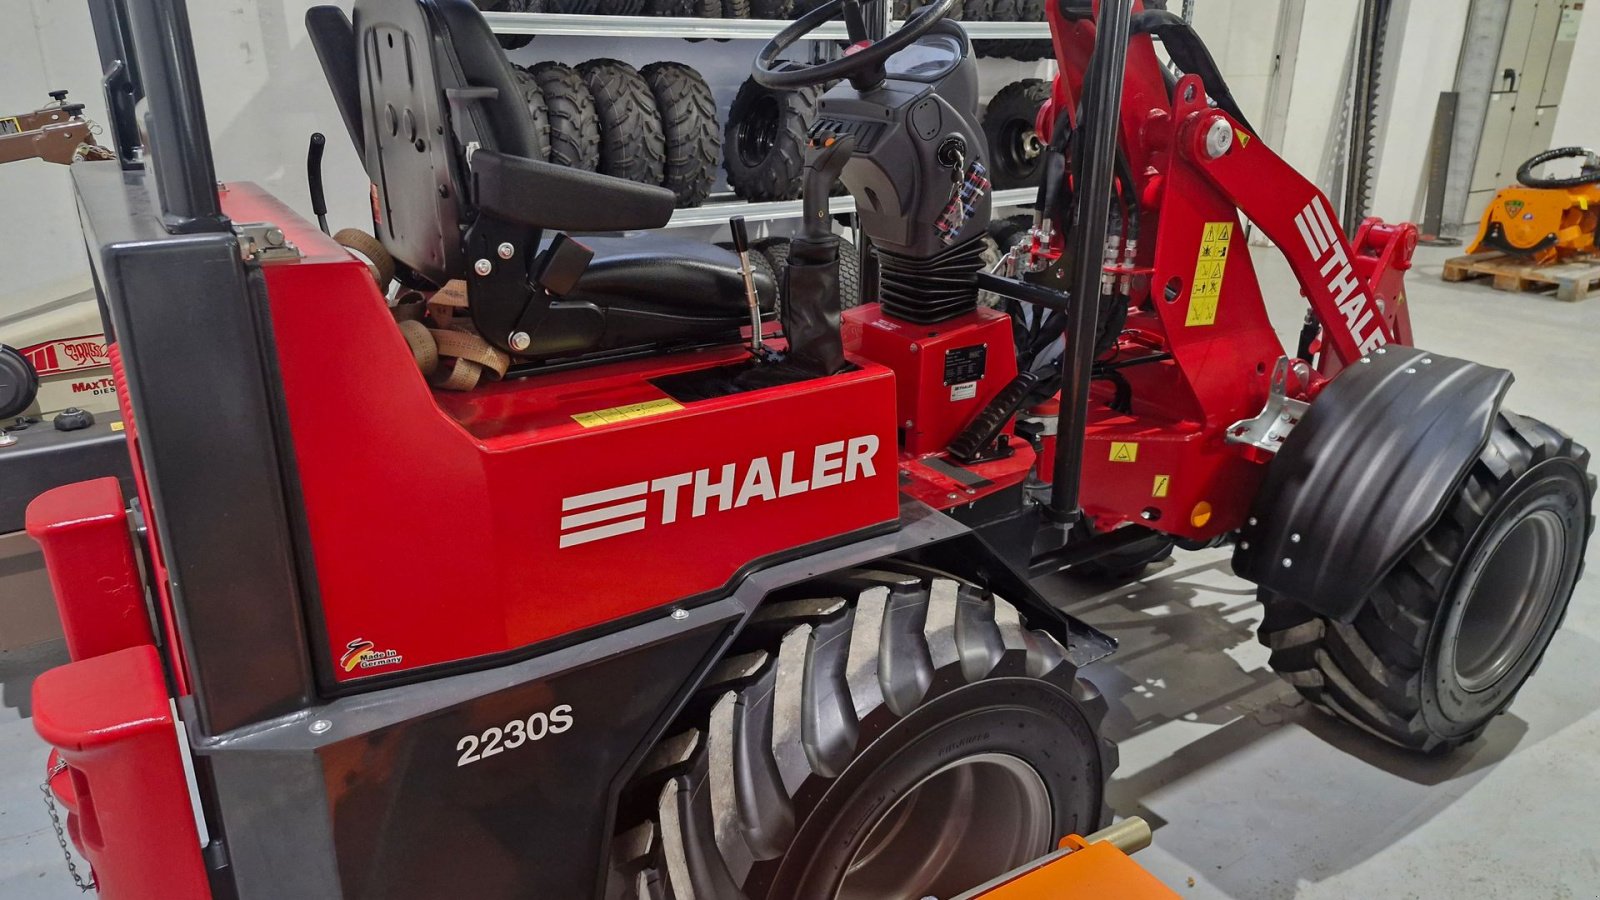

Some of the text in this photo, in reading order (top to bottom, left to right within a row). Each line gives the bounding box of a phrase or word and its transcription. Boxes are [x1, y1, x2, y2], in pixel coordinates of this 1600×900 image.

[93, 387, 116, 396] DIES
[651, 435, 880, 525] THALER
[360, 652, 385, 661] Made
[361, 656, 402, 668] Germany
[456, 704, 573, 767] 2230S
